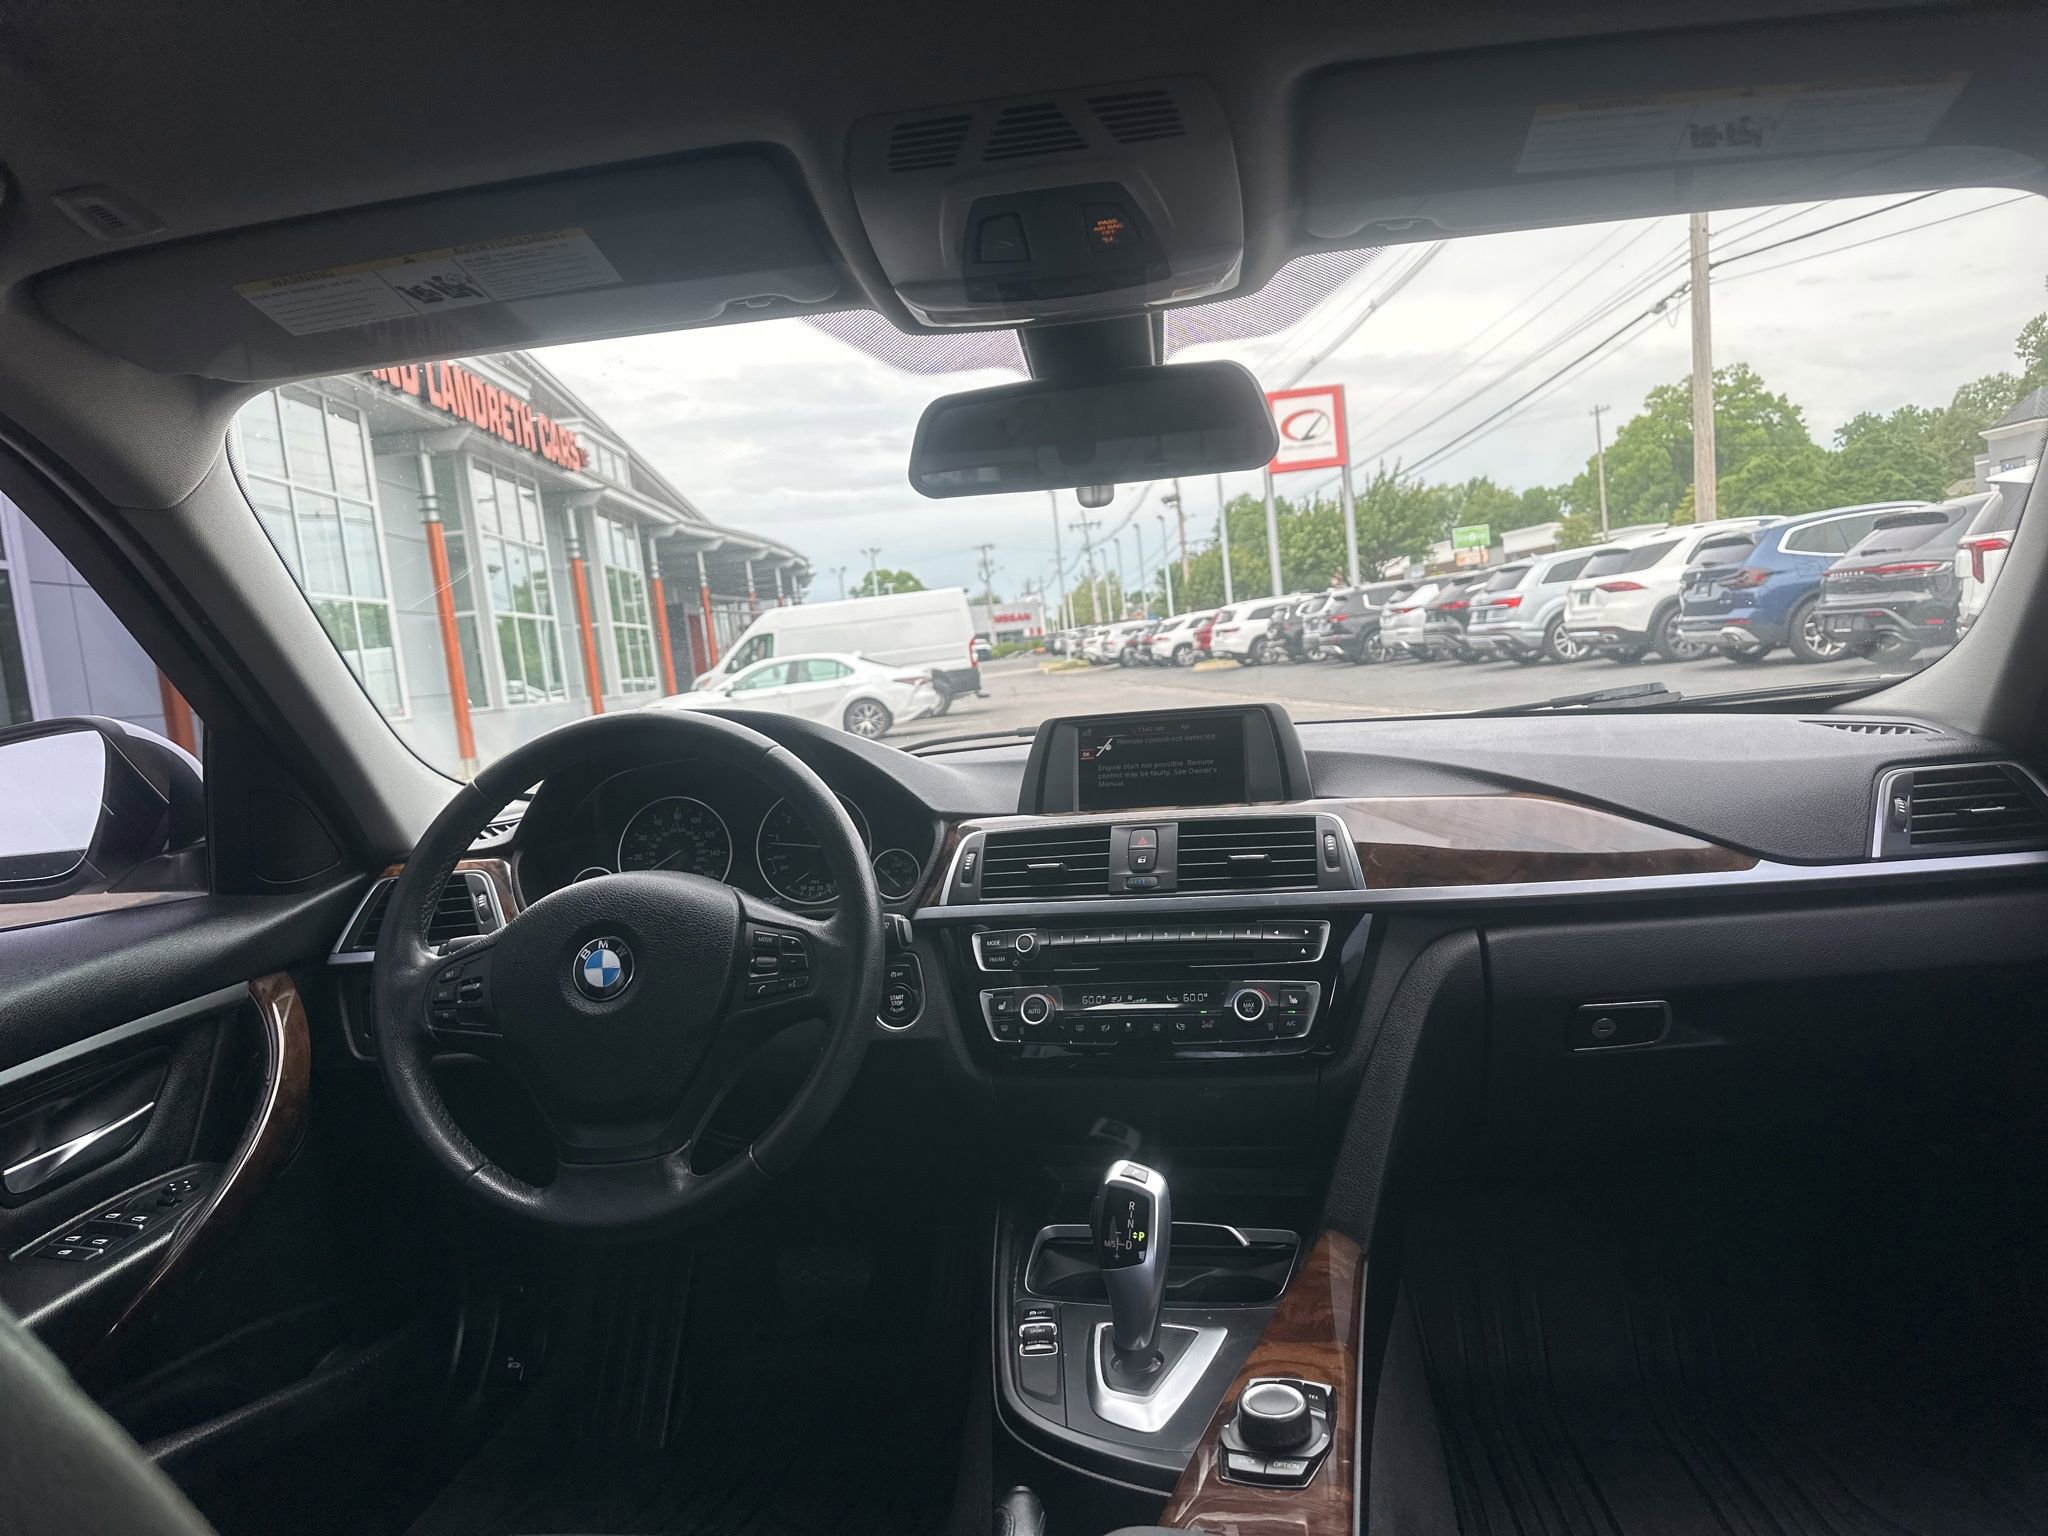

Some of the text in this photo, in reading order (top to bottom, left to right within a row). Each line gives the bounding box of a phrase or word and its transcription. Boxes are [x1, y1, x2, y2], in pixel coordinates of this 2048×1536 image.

[269, 270, 336, 288] WARNING
[425, 360, 538, 454] LANDRETH
[537, 412, 581, 473] CARS
[1145, 736, 1169, 744] control
[1171, 735, 1183, 743] not
[1184, 733, 1216, 741] detected
[1098, 764, 1121, 772] Engine
[1123, 762, 1139, 770] start
[1141, 761, 1152, 769] not
[1187, 758, 1214, 766] Remote
[1098, 771, 1122, 779] control
[1189, 767, 1217, 775] Owner's
[580, 940, 628, 960] BMW
[1128, 1201, 1136, 1211] R
[1127, 1219, 1134, 1229] N
[1138, 1231, 1145, 1242] P
[1125, 1241, 1132, 1250] D
[1273, 1461, 1300, 1470] OPTION
